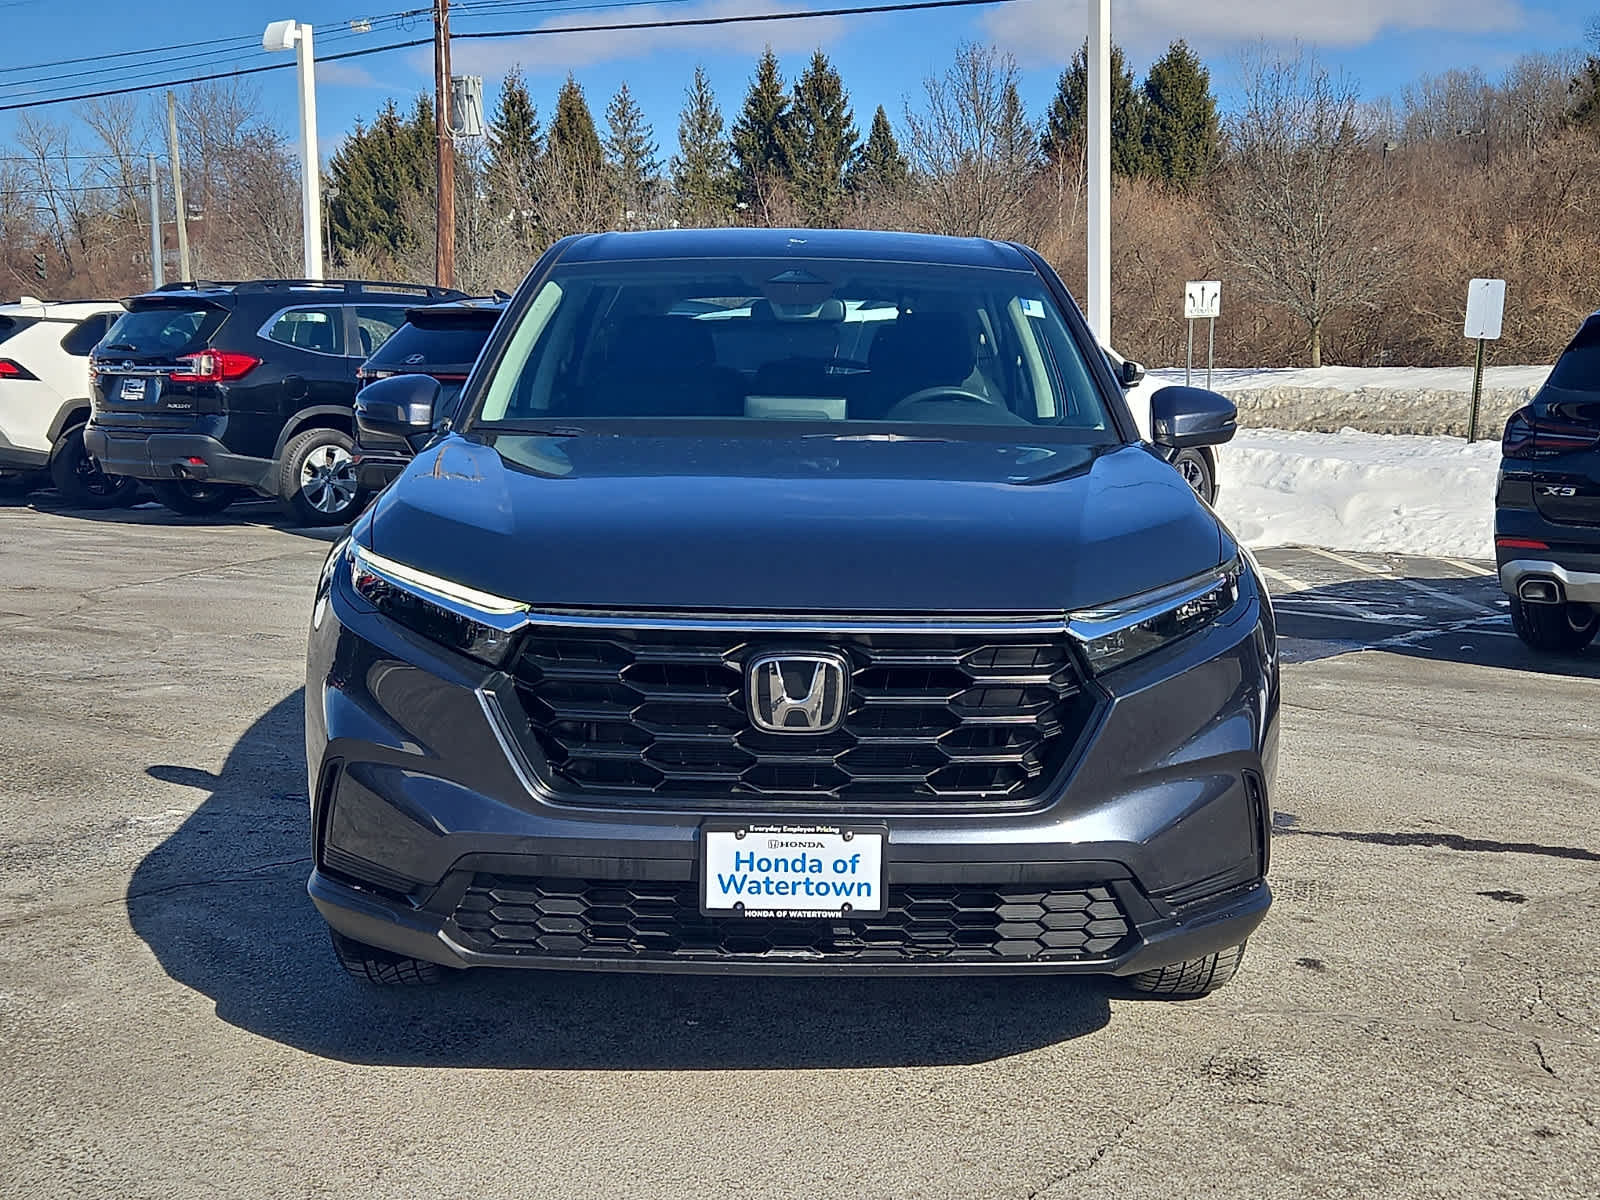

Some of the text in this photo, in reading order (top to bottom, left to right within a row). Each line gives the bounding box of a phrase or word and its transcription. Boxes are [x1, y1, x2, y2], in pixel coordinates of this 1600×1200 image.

[1543, 486, 1577, 497] X3
[749, 824, 782, 833] Everyday
[815, 825, 840, 834] Pricing
[780, 841, 825, 849] HONDA
[735, 851, 861, 875] Honda of
[717, 873, 872, 897] Watertown
[744, 910, 843, 918] HONDA OF WATERTOWN
